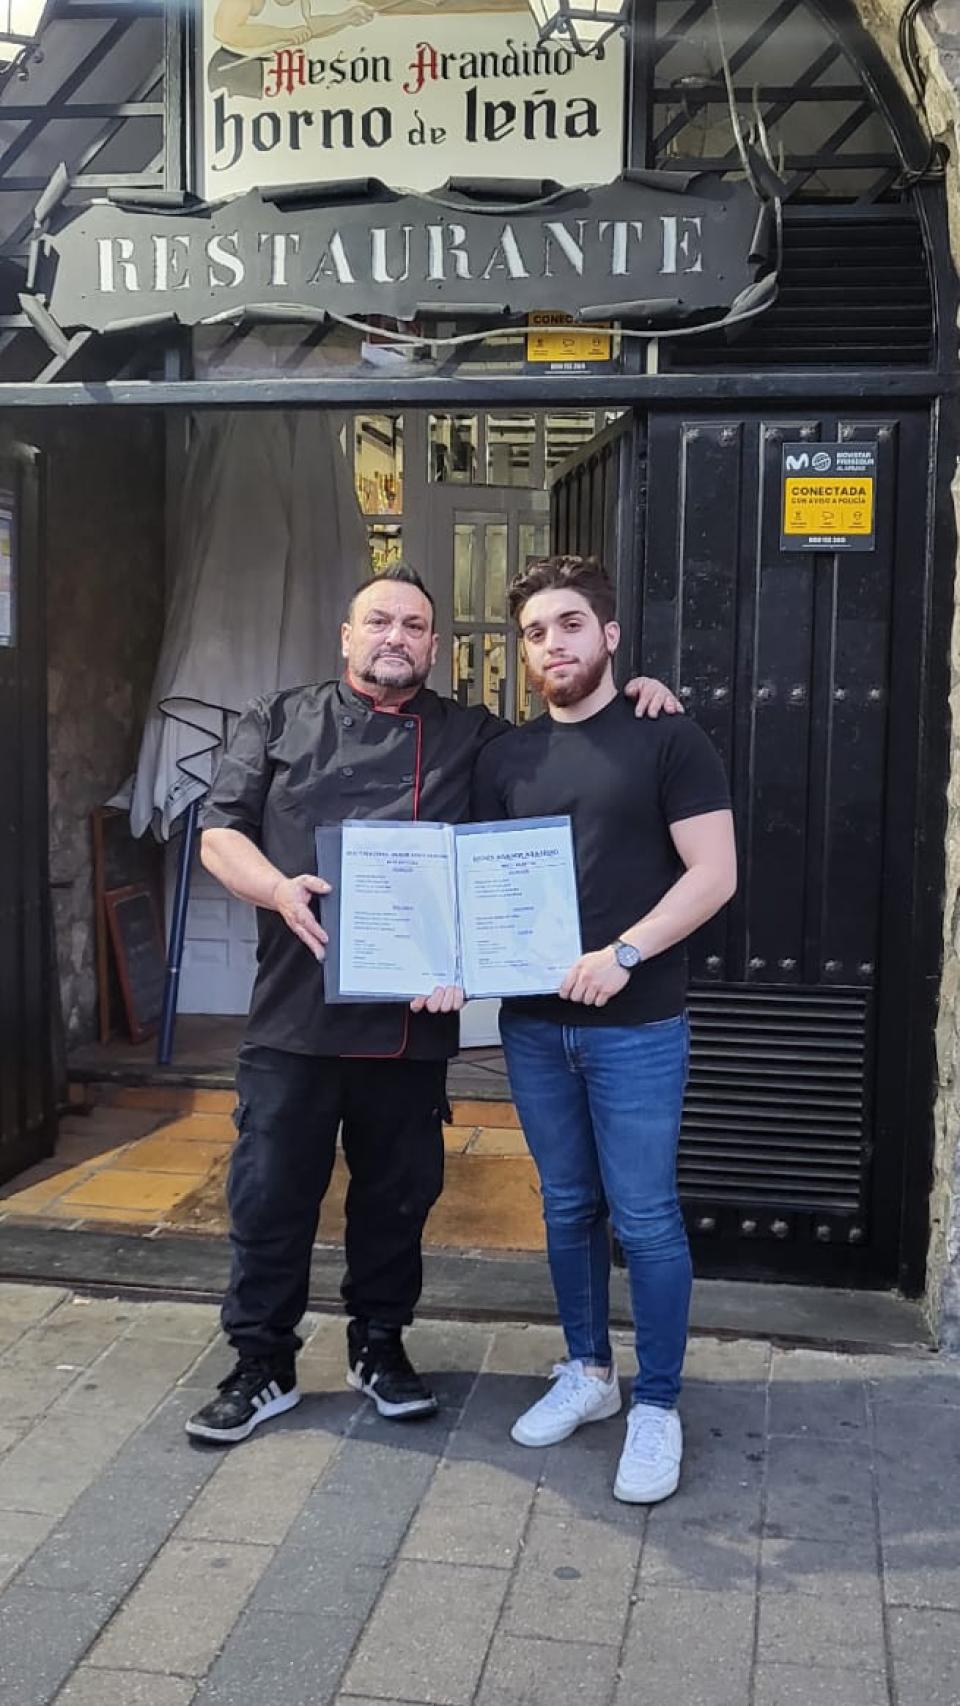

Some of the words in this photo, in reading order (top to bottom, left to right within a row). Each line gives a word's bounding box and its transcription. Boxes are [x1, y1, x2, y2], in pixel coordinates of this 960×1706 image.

[265, 46, 392, 97] Mesón
[402, 38, 574, 95] Arandino
[211, 89, 393, 171] horno
[408, 110, 447, 146] de
[465, 86, 601, 143] leña
[97, 216, 703, 293] RESTAURANTE
[792, 487, 866, 496] CONECTADA
